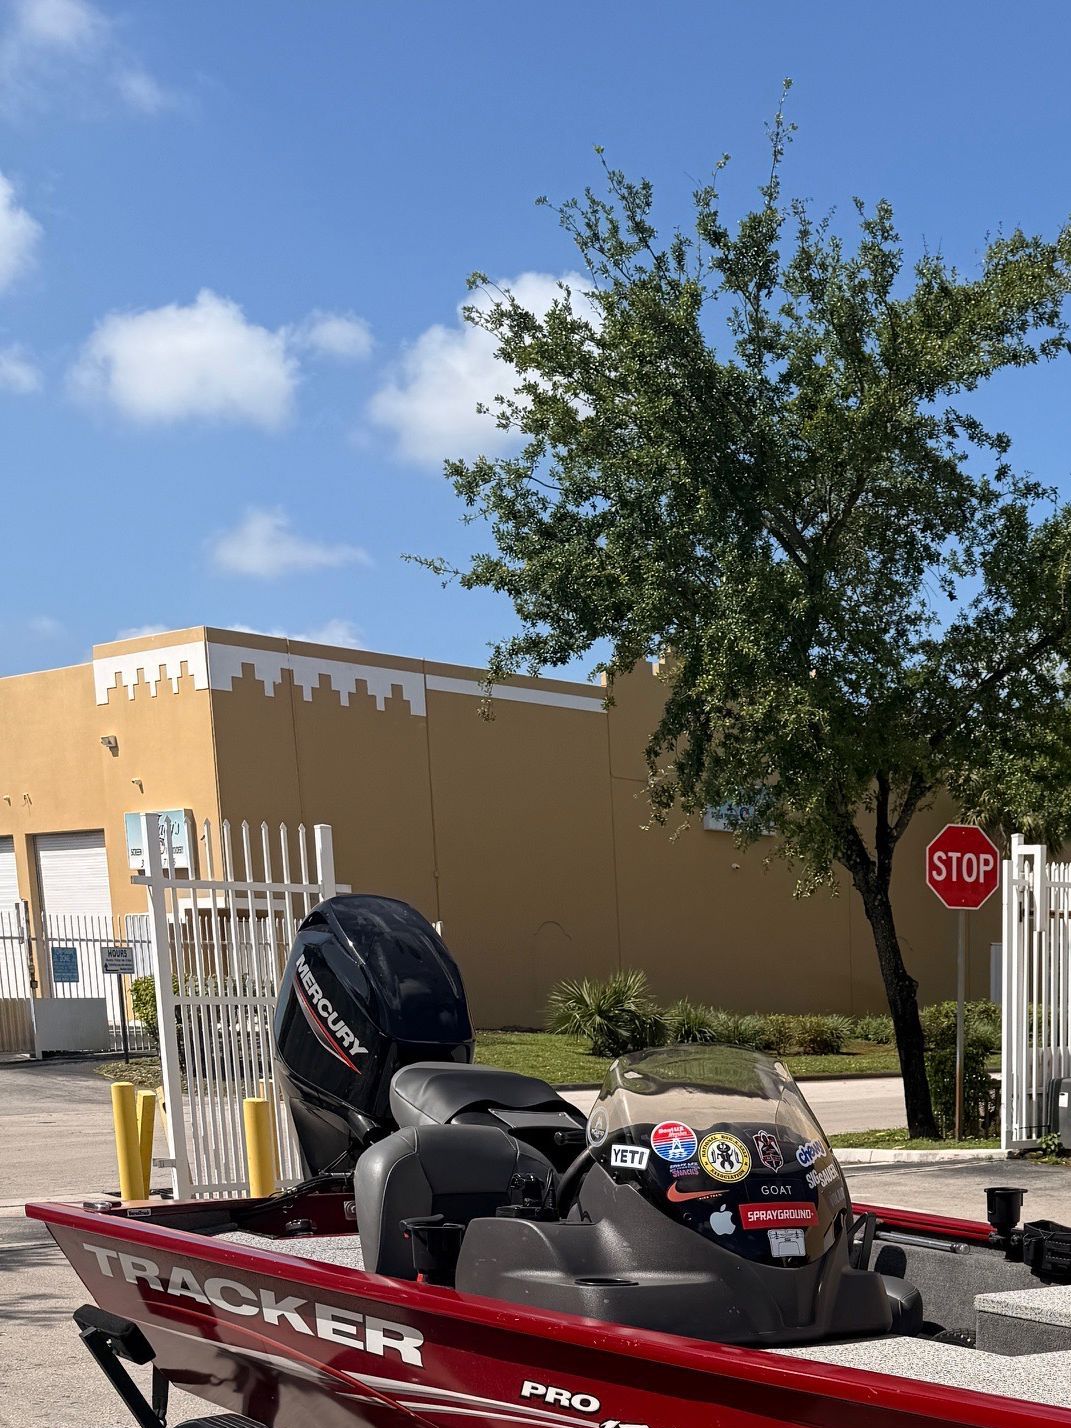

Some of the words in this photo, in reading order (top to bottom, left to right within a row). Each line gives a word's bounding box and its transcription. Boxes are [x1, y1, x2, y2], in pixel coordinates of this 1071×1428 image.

[932, 851, 994, 883] STOP
[107, 949, 128, 958] HOURS
[296, 953, 369, 1056] MERCURY
[613, 1148, 645, 1166] YETI
[806, 1169, 821, 1189] SIG
[820, 1164, 839, 1188] SAUER
[761, 1185, 792, 1195] GOAT
[747, 1209, 812, 1222] SPRAYGROUND
[83, 1243, 425, 1369] TRACKER
[520, 1380, 600, 1414] PRO
